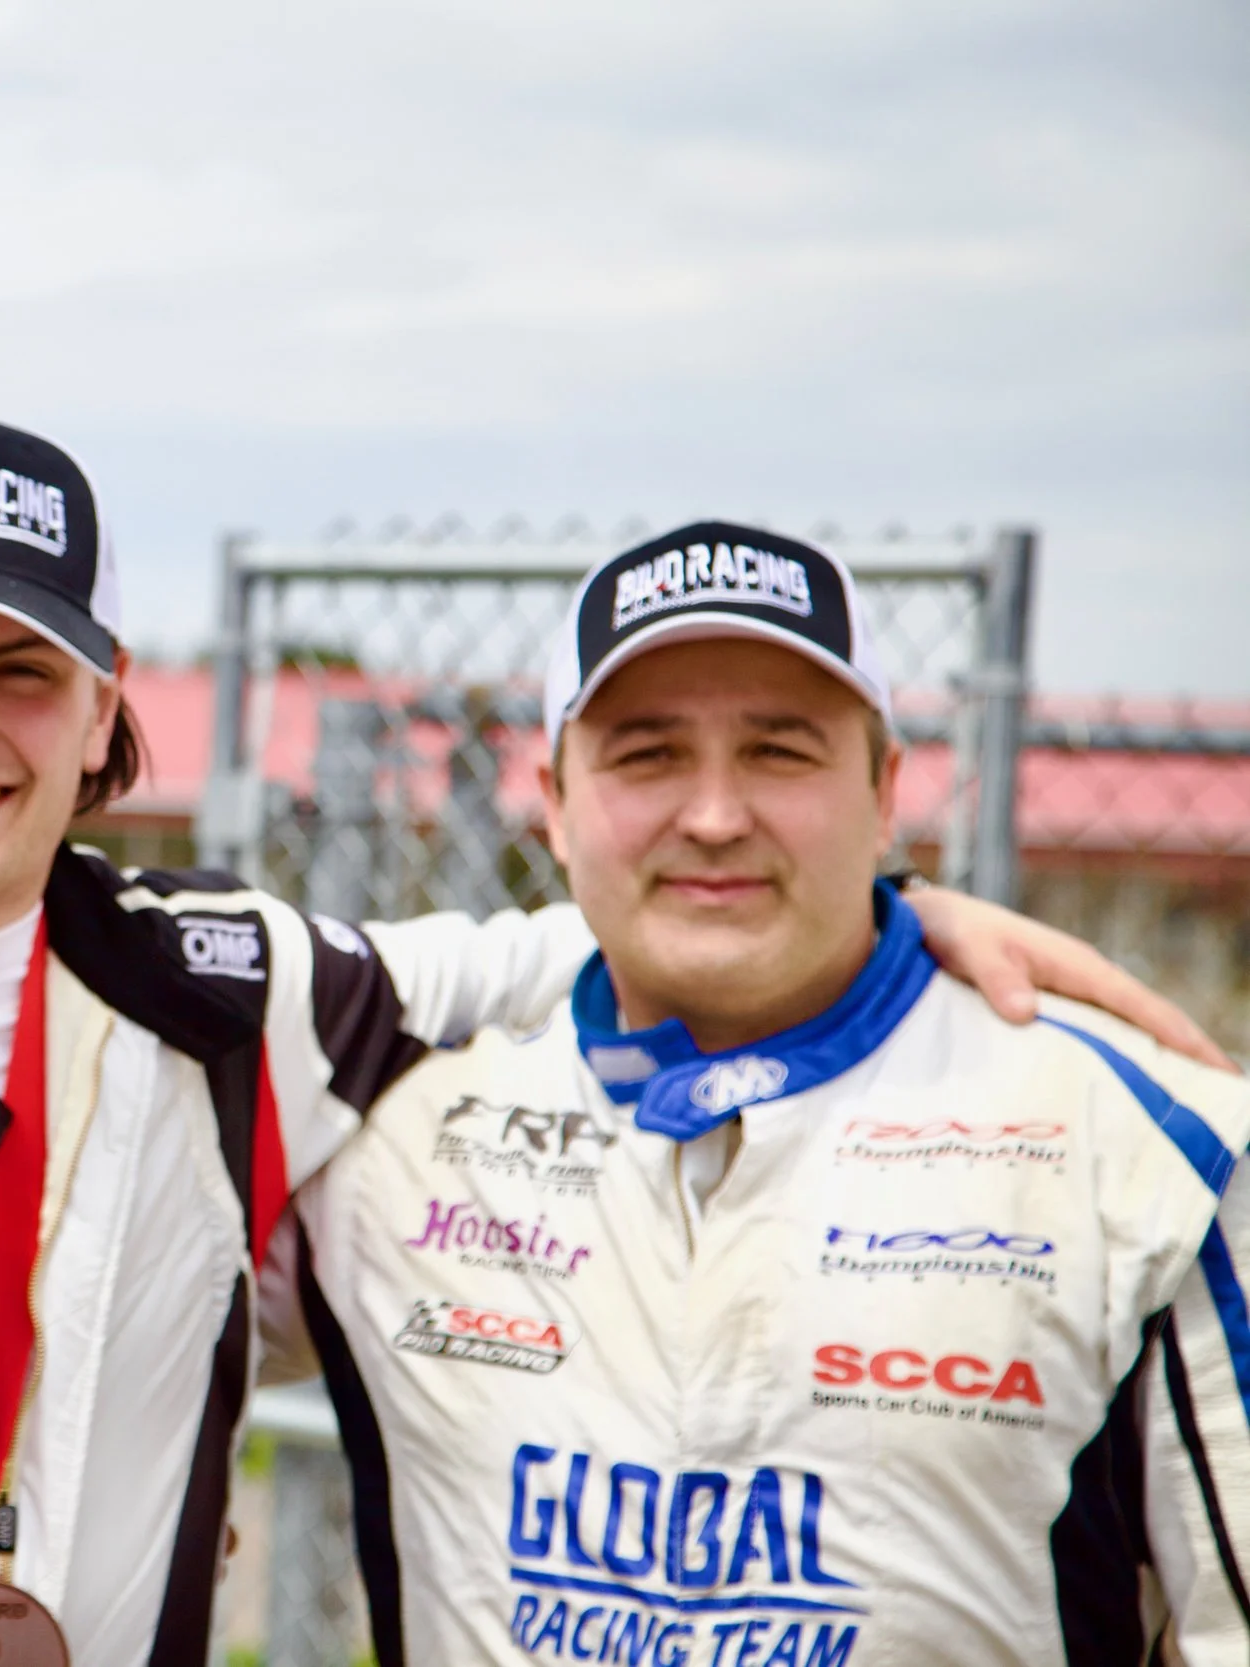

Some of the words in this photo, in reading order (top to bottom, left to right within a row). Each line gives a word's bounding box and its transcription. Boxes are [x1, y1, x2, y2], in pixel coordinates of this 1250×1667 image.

[181, 928, 260, 966] OMP
[451, 1309, 563, 1350] SCCA
[448, 1338, 558, 1372] RACING
[813, 1344, 1046, 1407] SCCA
[812, 1391, 869, 1409] Sports
[910, 1400, 954, 1419] Club
[959, 1407, 977, 1421] of
[509, 1443, 862, 1588] GLOBAL
[510, 1594, 694, 1667] RACING
[710, 1619, 859, 1667] TEAM
